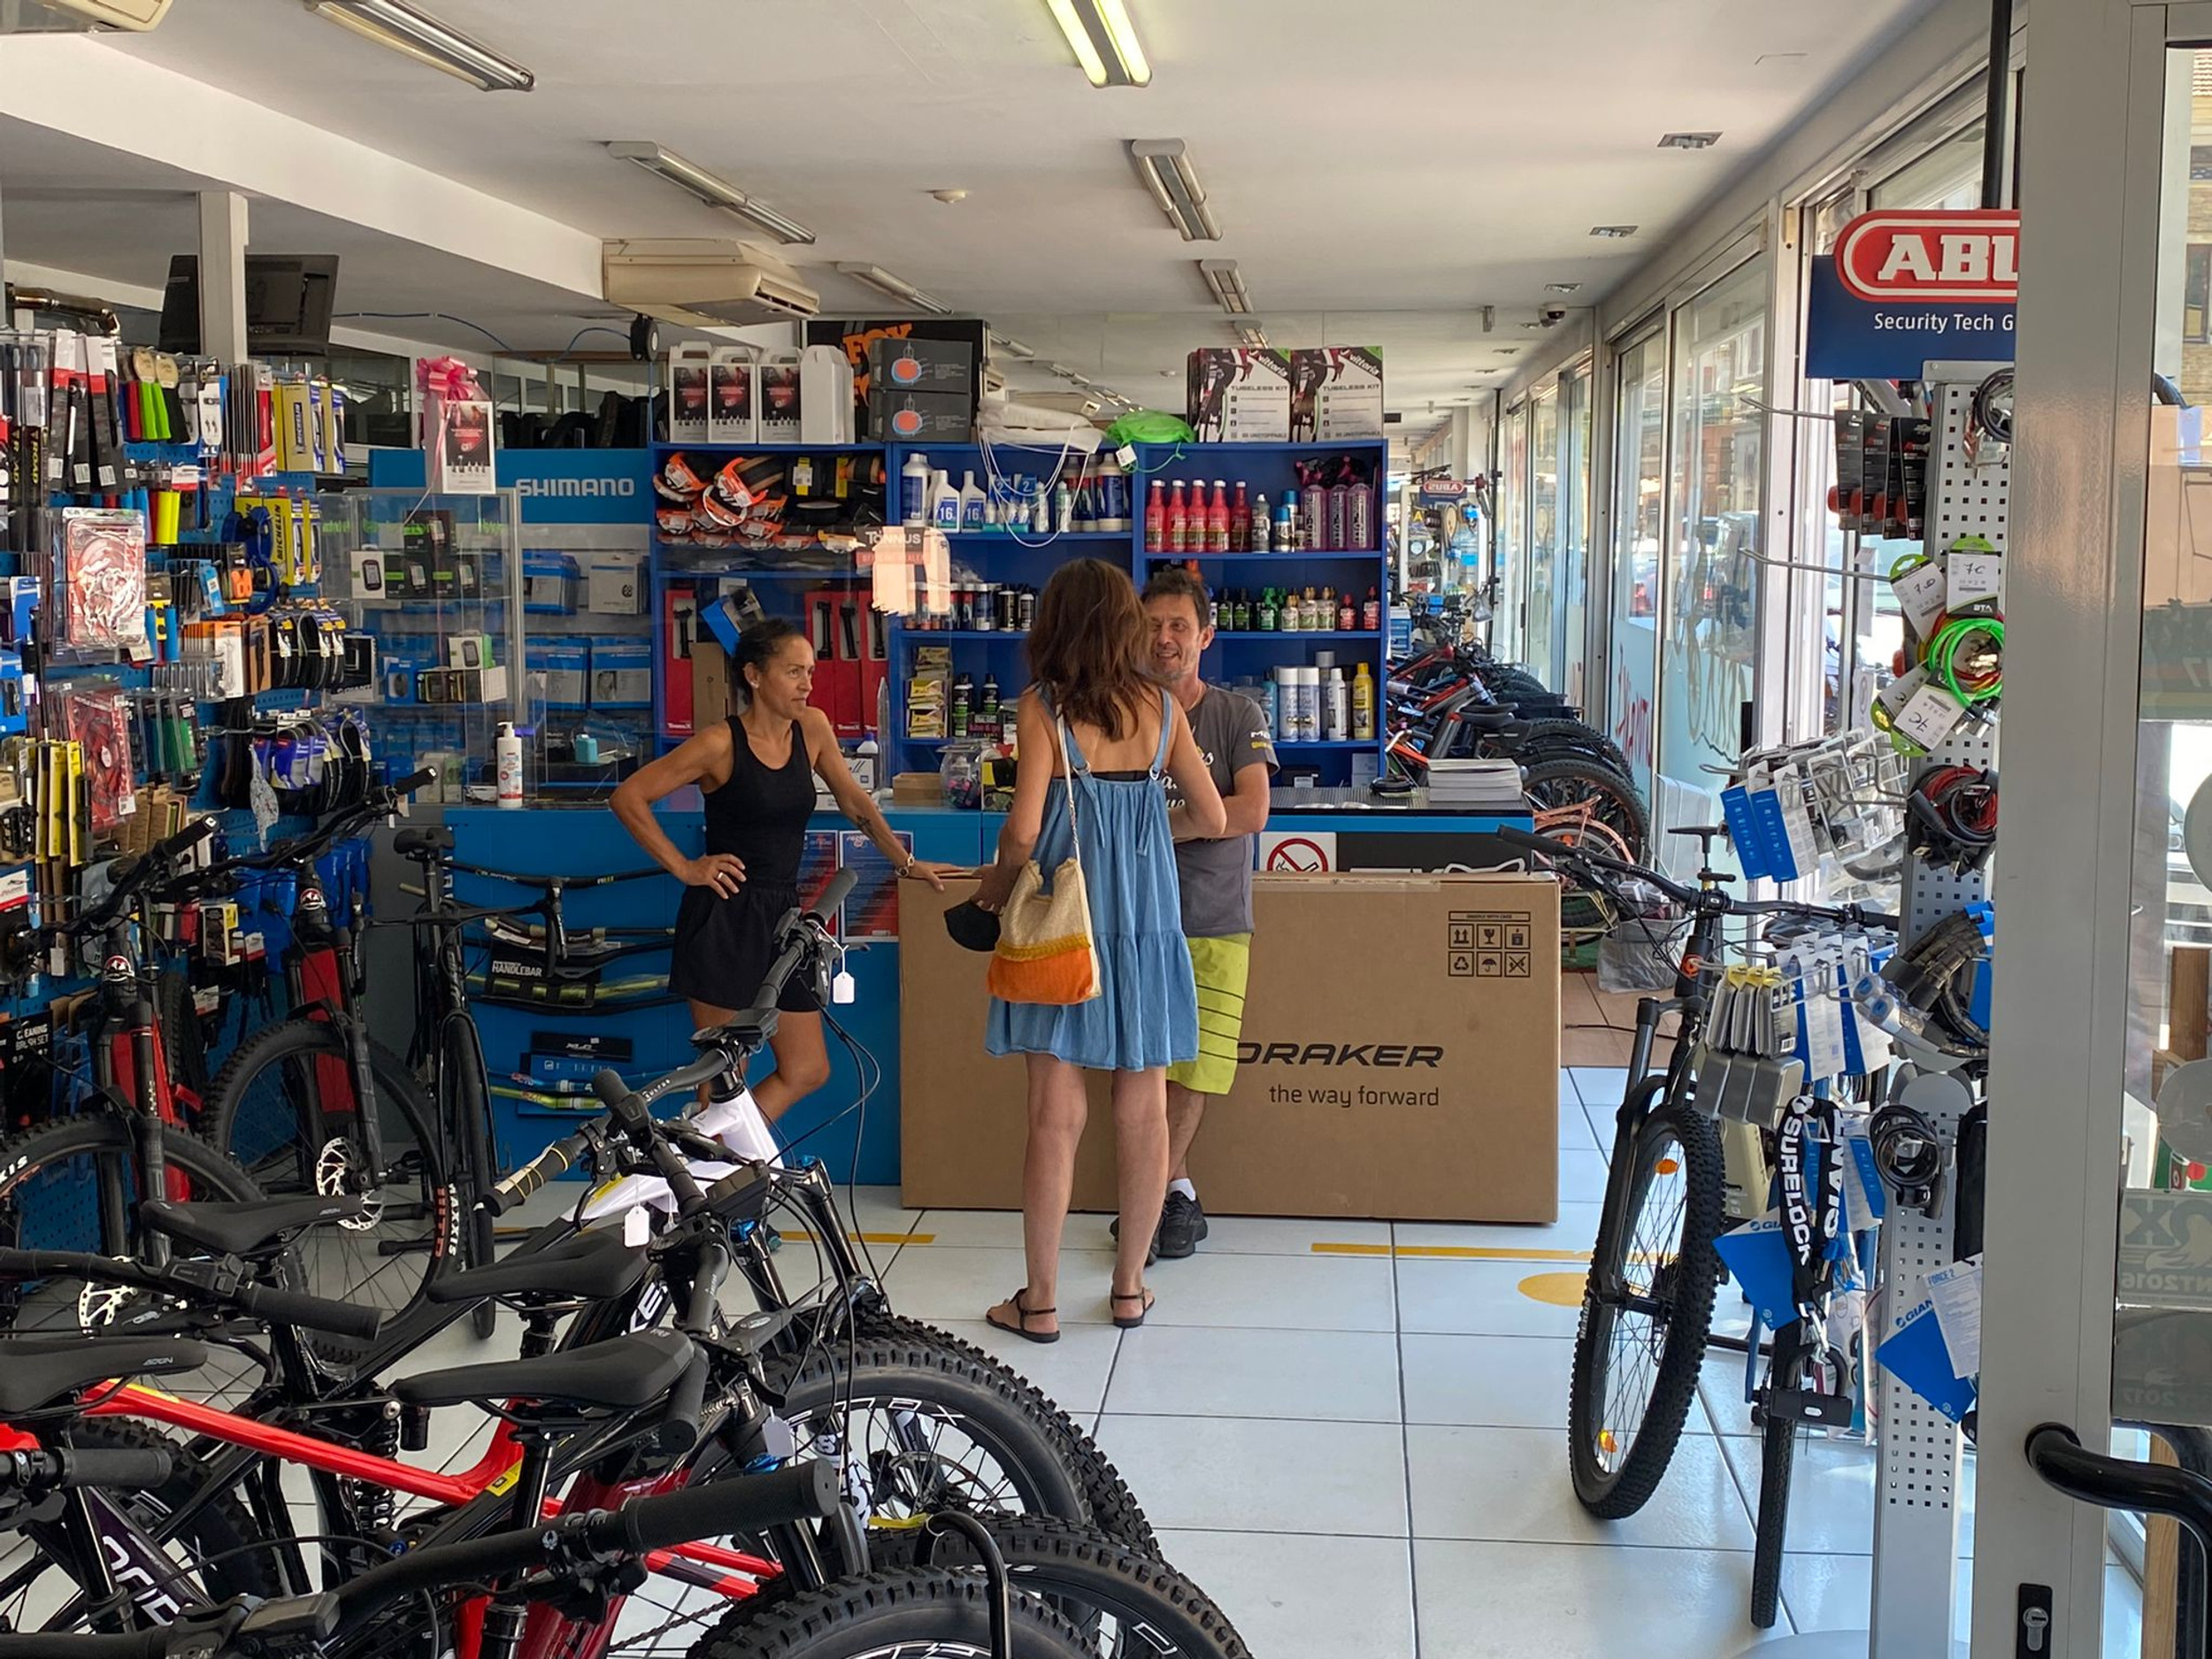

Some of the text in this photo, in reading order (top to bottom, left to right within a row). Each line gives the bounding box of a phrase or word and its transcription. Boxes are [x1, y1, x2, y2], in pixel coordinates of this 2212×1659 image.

[1873, 312, 2015, 333] Security Tech G
[516, 477, 635, 497] SHIMANO
[940, 507, 953, 521] 16
[966, 507, 979, 521] 16
[274, 504, 283, 560] MICHELIN
[492, 961, 542, 978] HANDLEBAR
[16, 1024, 48, 1040] CEANING
[1237, 1041, 1444, 1068] DRAKER
[1270, 1085, 1440, 1108] the way forward
[1779, 1116, 1812, 1266] SURELOCK
[448, 1182, 460, 1256] MAXXIS
[1905, 1299, 1933, 1323] GIAN
